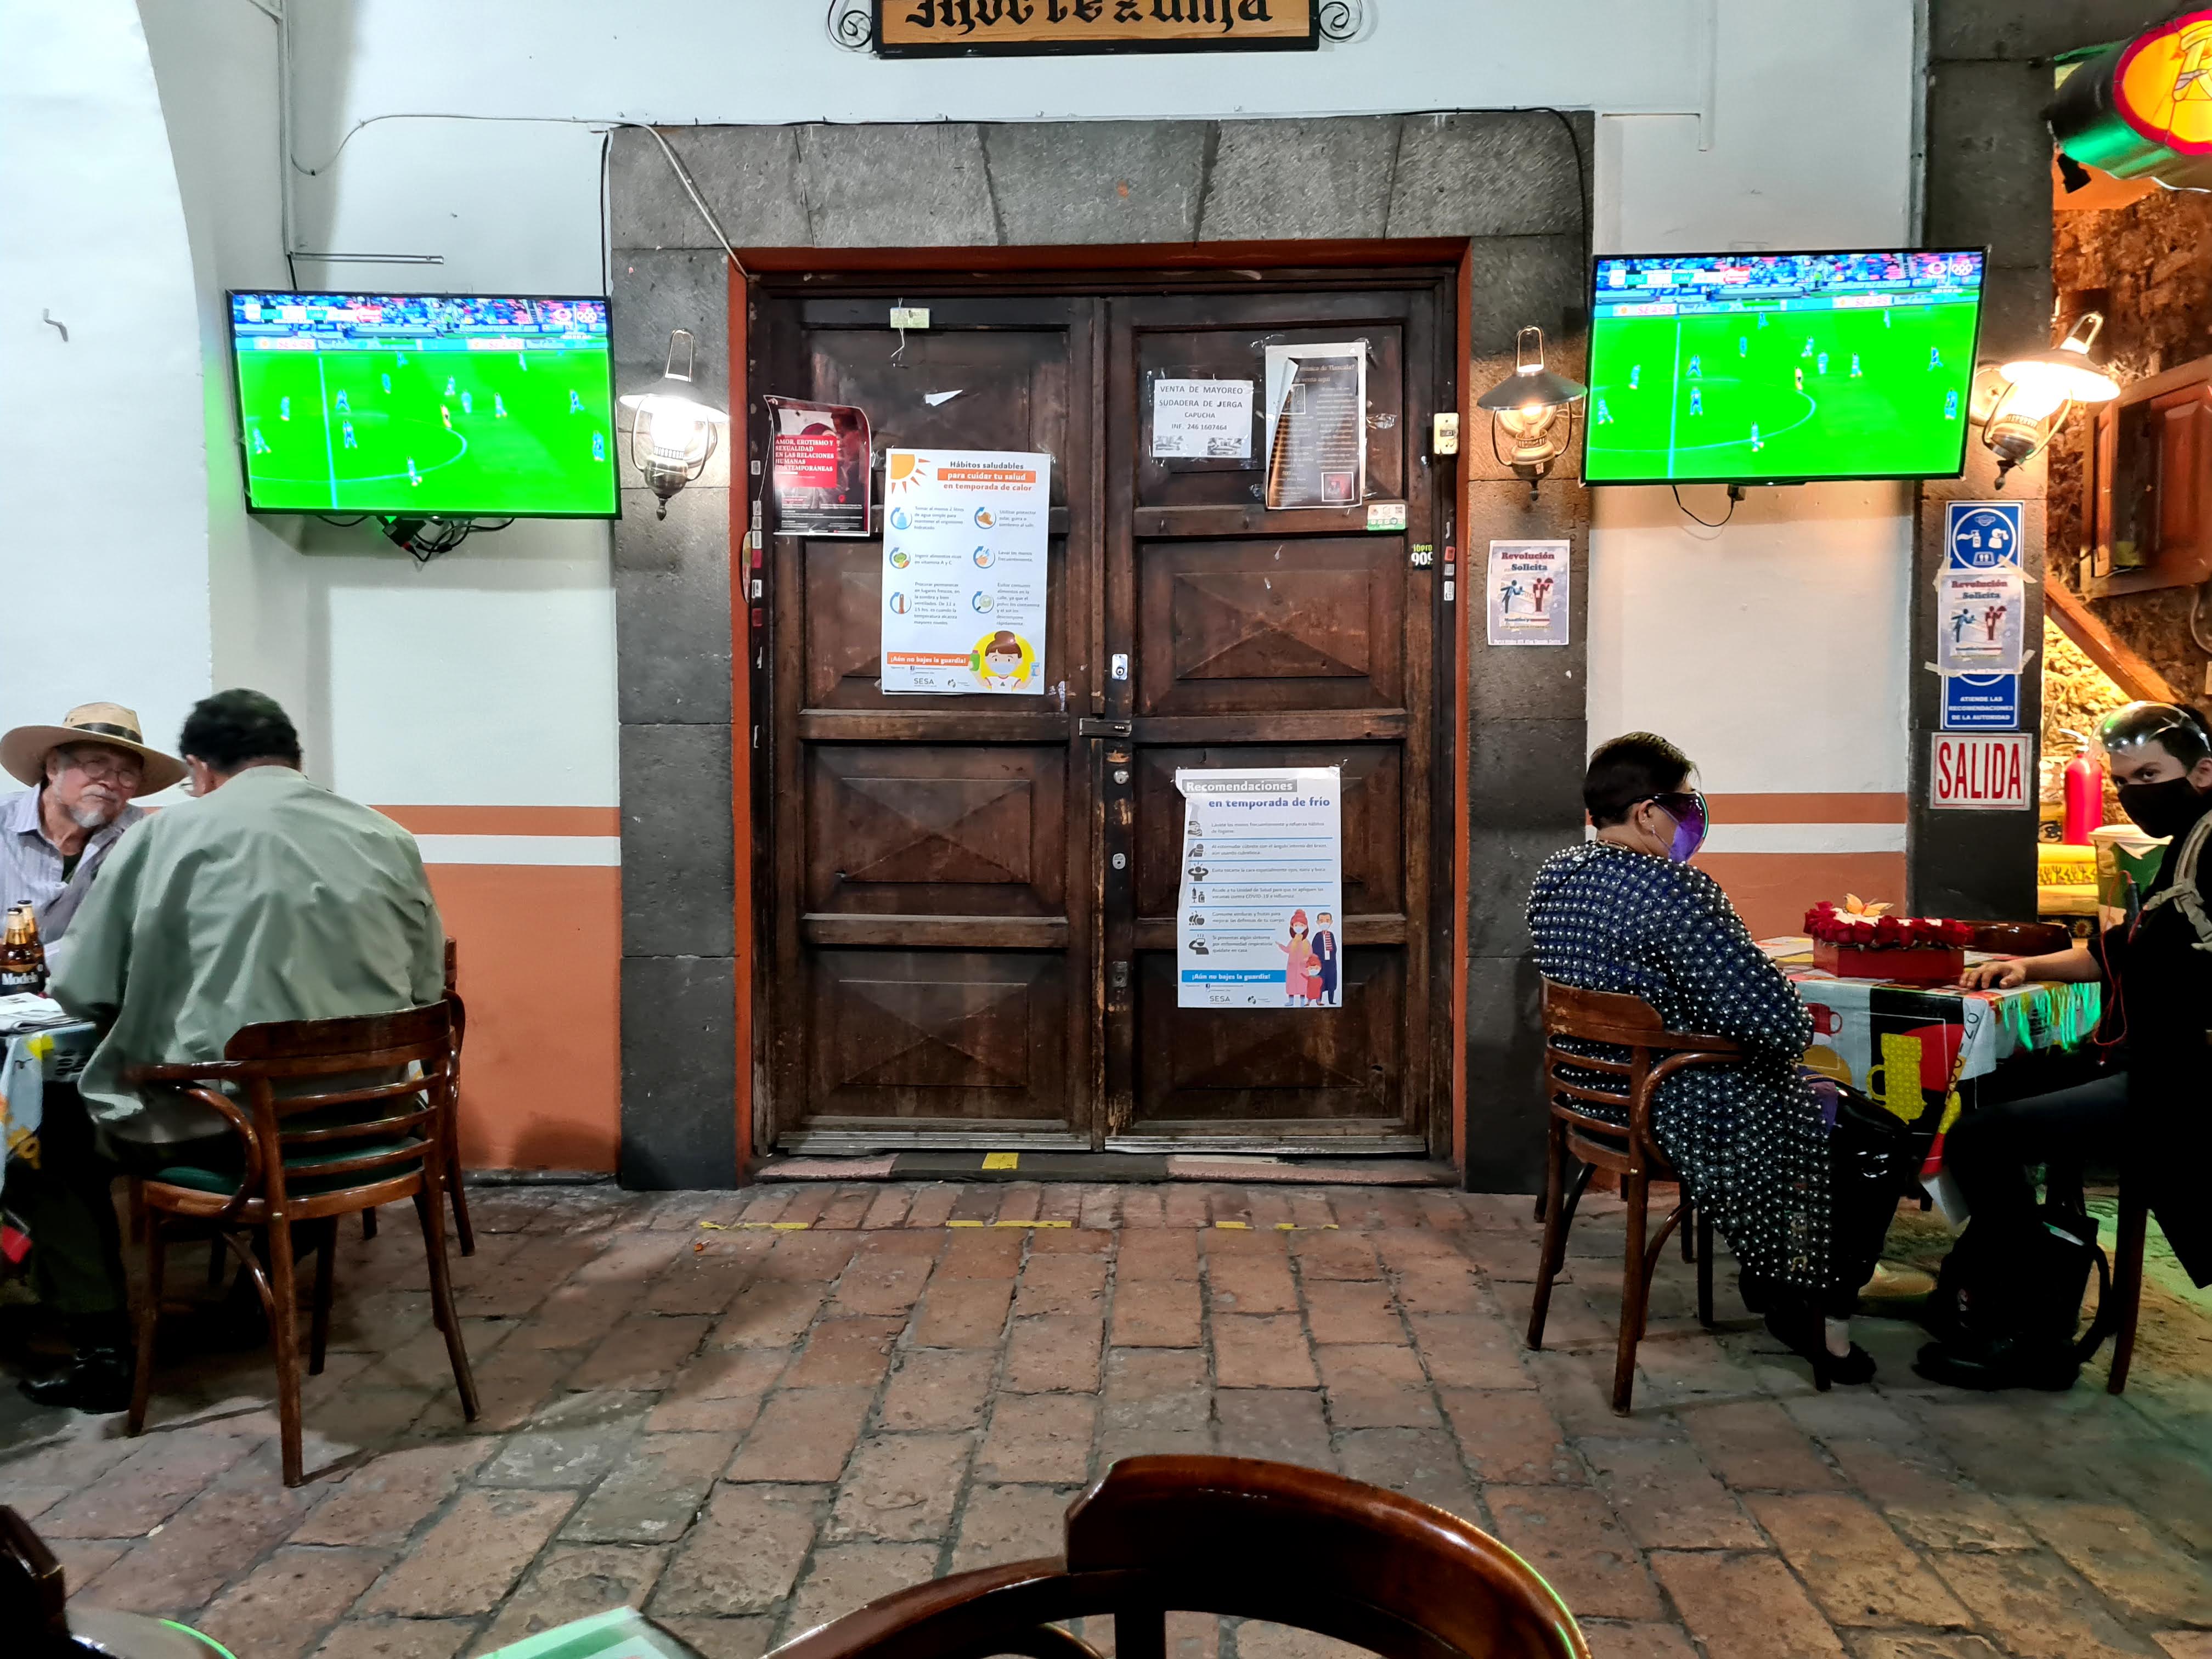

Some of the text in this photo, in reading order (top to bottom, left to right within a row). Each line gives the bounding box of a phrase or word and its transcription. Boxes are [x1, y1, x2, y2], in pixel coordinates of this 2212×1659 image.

[1638, 305, 1673, 315] SEARS
[947, 472, 966, 481] para
[967, 472, 992, 480] cuidar
[1005, 472, 1026, 481] salud
[956, 483, 998, 492] temporada
[1501, 552, 1555, 560] Revolución
[1951, 579, 2008, 588] Revolución
[916, 656, 933, 664] bajes
[1938, 742, 2022, 799] SALIDA
[1186, 781, 1293, 792] Recomendaciones
[1226, 797, 1289, 810] temporada
[1292, 797, 1306, 807] de
[1309, 796, 1330, 806] frío
[1244, 973, 1271, 981] guardia!
